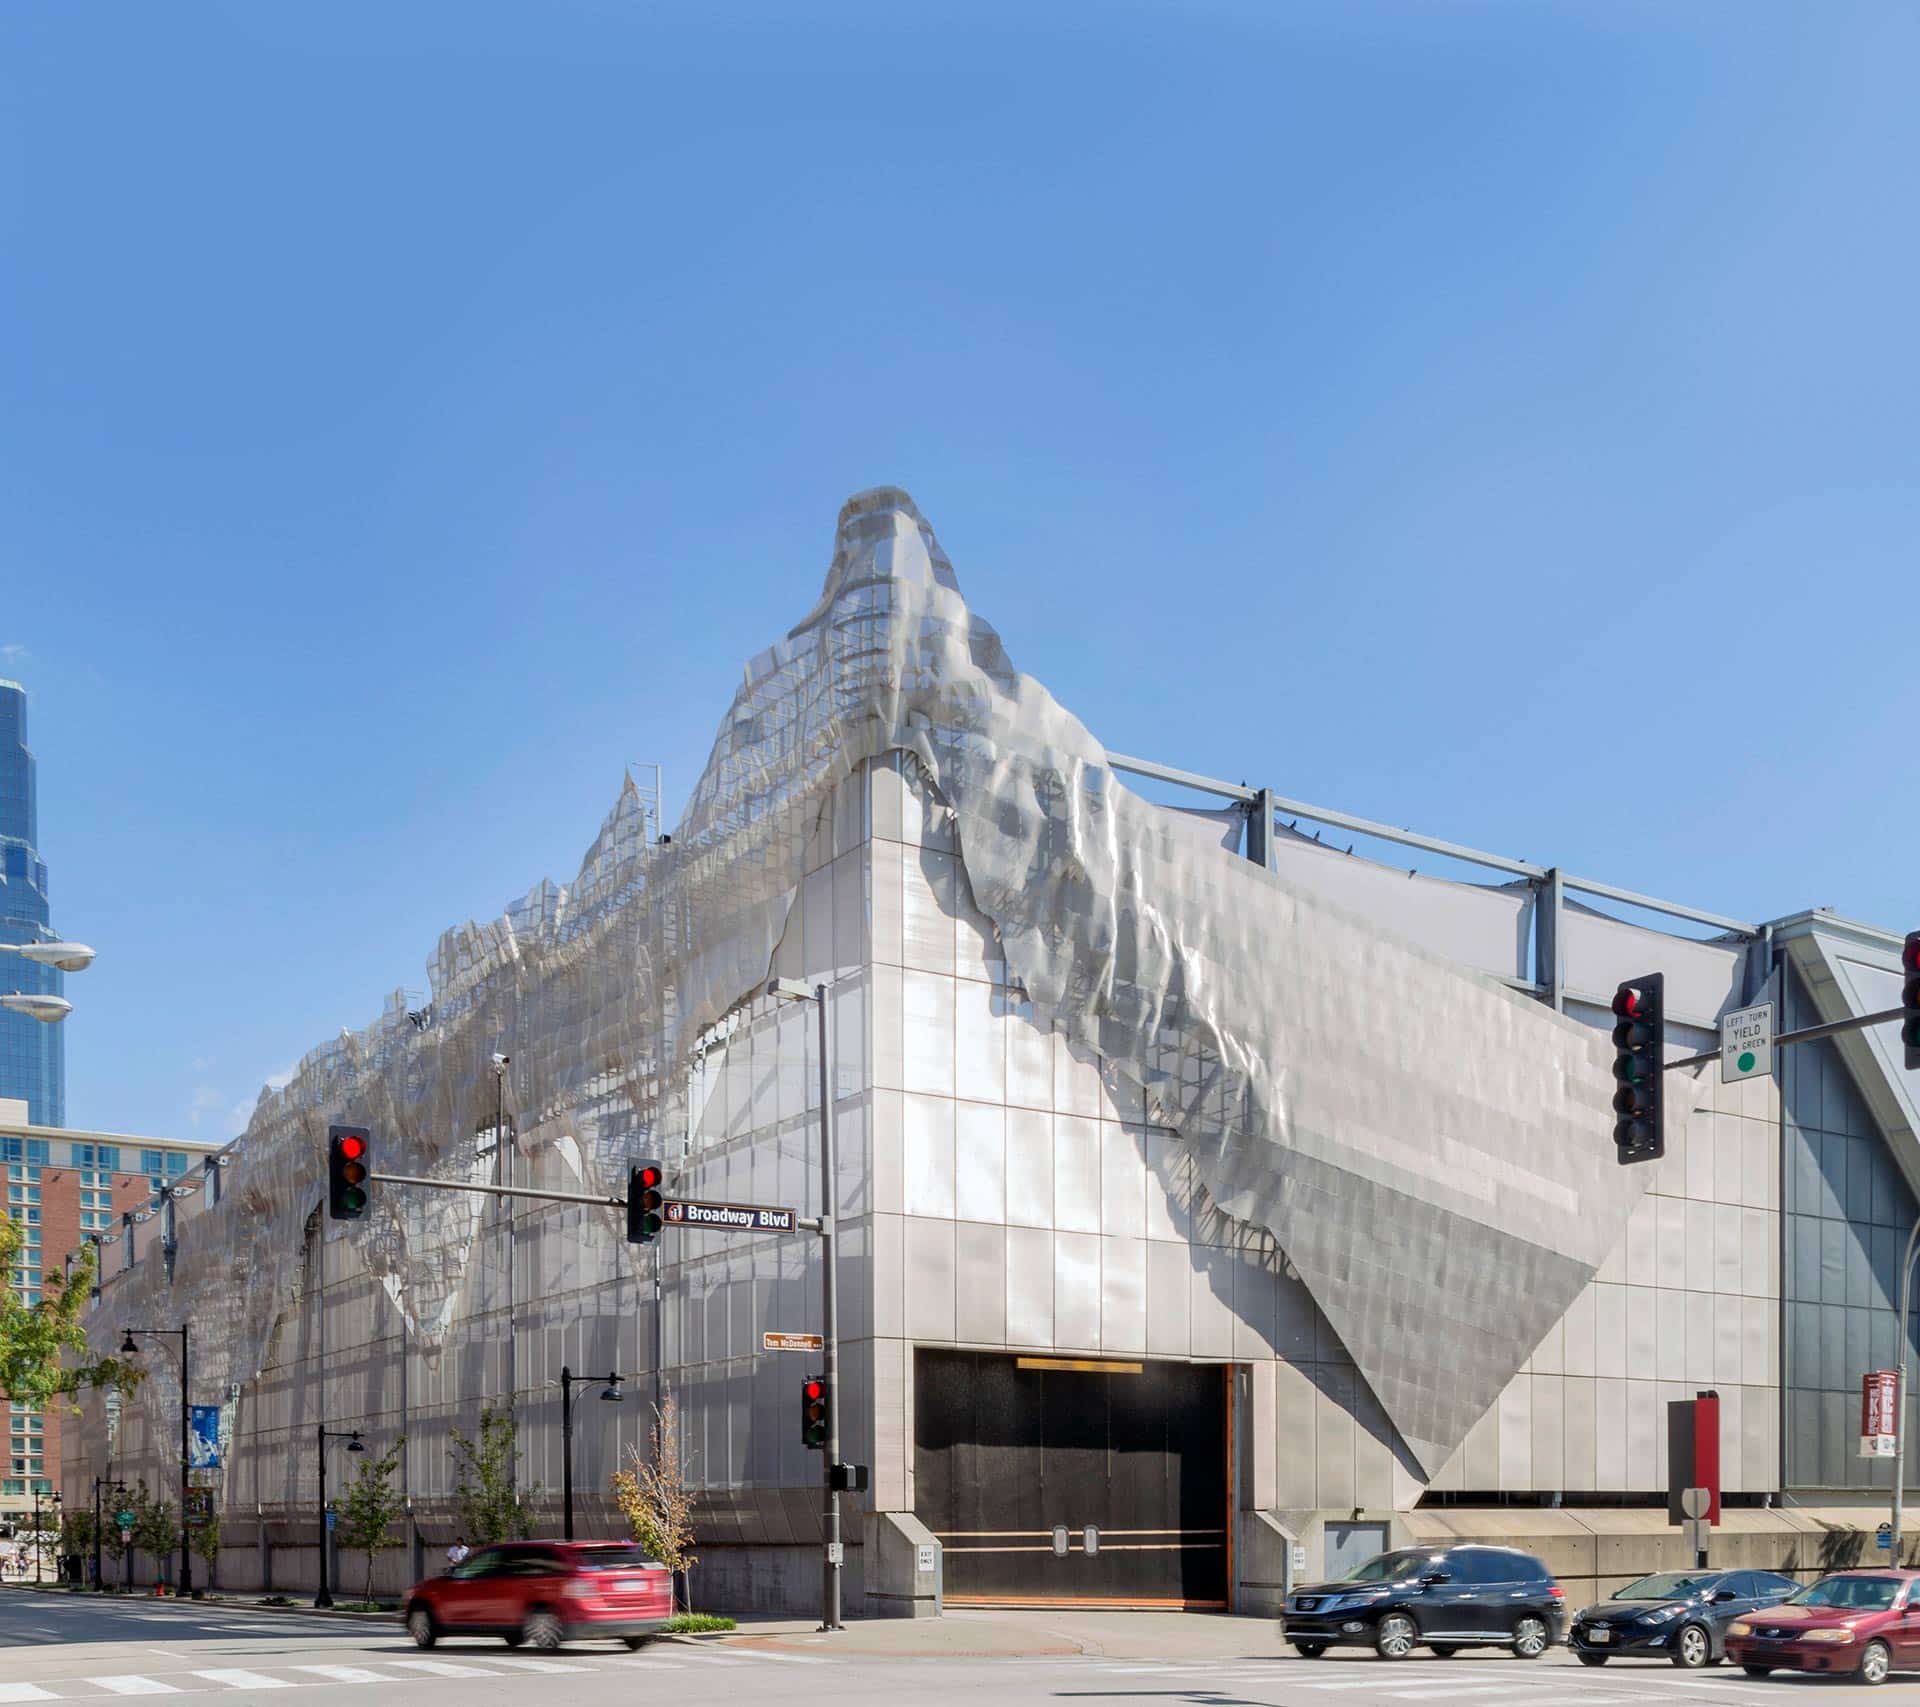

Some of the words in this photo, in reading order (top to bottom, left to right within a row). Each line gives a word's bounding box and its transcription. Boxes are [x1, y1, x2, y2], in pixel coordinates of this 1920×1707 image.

[1727, 1016, 1743, 1028] LEFT
[1749, 1011, 1768, 1023] TURN
[1734, 1024, 1760, 1040] YIELD
[1727, 1043, 1737, 1054] ON
[1742, 1038, 1766, 1050] GREEN
[687, 1205, 754, 1228] Broadway
[759, 1211, 789, 1227] Blvd
